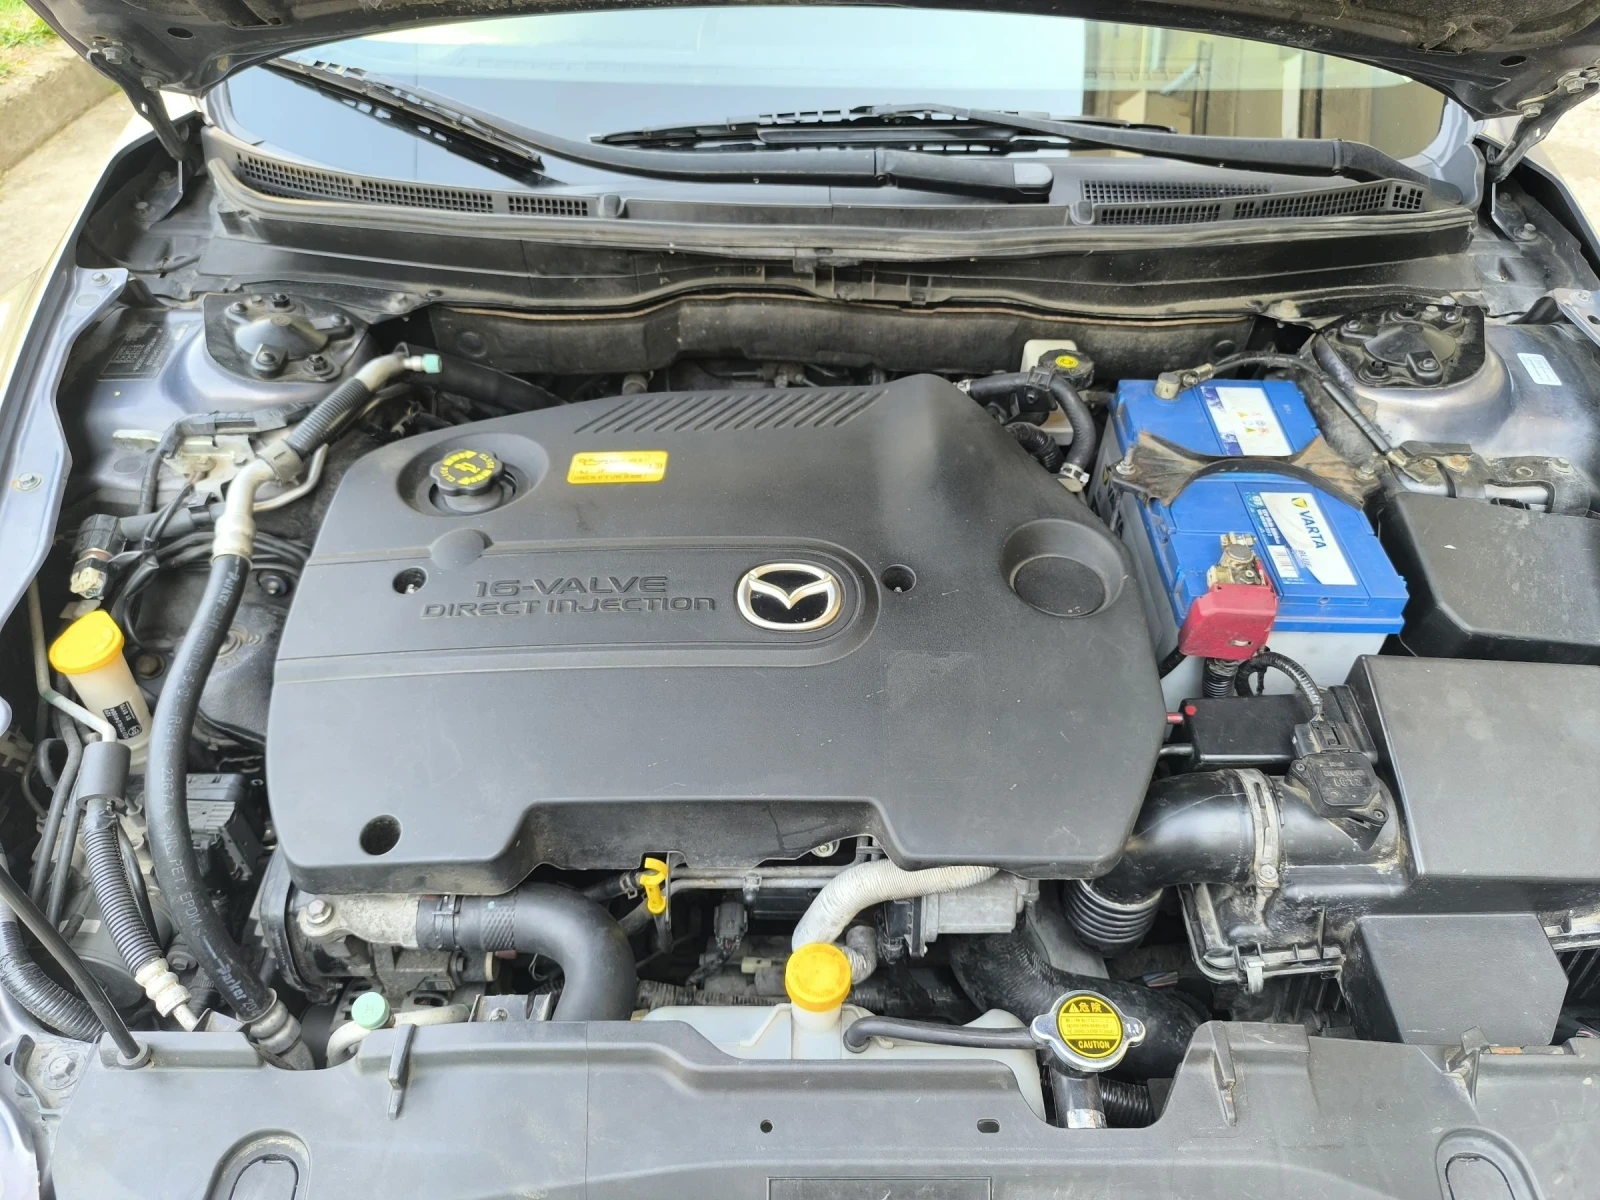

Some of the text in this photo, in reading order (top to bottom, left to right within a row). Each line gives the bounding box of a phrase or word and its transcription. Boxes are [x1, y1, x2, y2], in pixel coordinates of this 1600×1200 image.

[1299, 510, 1327, 549] VARTA
[475, 576, 668, 597] 16-VALVE
[422, 600, 540, 618] DIRECT
[180, 891, 203, 926] EPDM
[216, 963, 247, 1000] Parker
[1078, 1040, 1110, 1049] CAUTION
